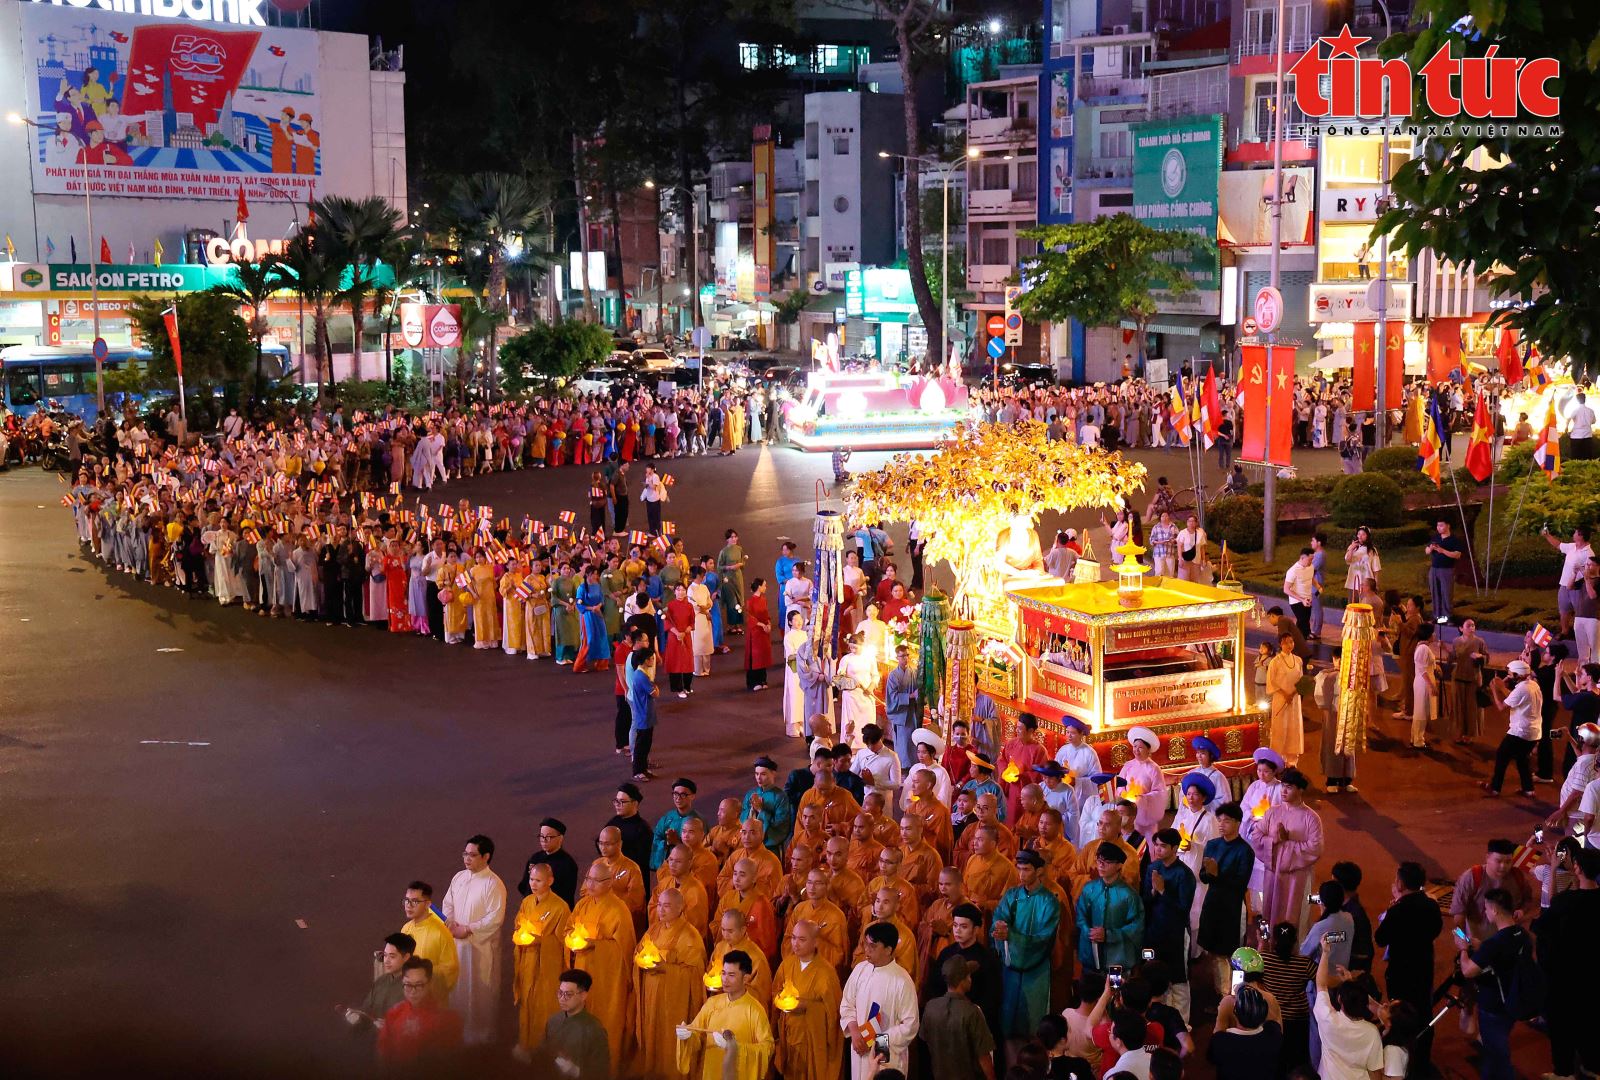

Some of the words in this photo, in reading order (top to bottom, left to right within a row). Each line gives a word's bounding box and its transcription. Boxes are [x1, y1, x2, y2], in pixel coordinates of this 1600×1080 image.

[1194, 130, 1210, 142] MINH
[128, 184, 146, 193] NAM
[56, 272, 124, 287] SAIGON
[127, 272, 184, 288] PETRO
